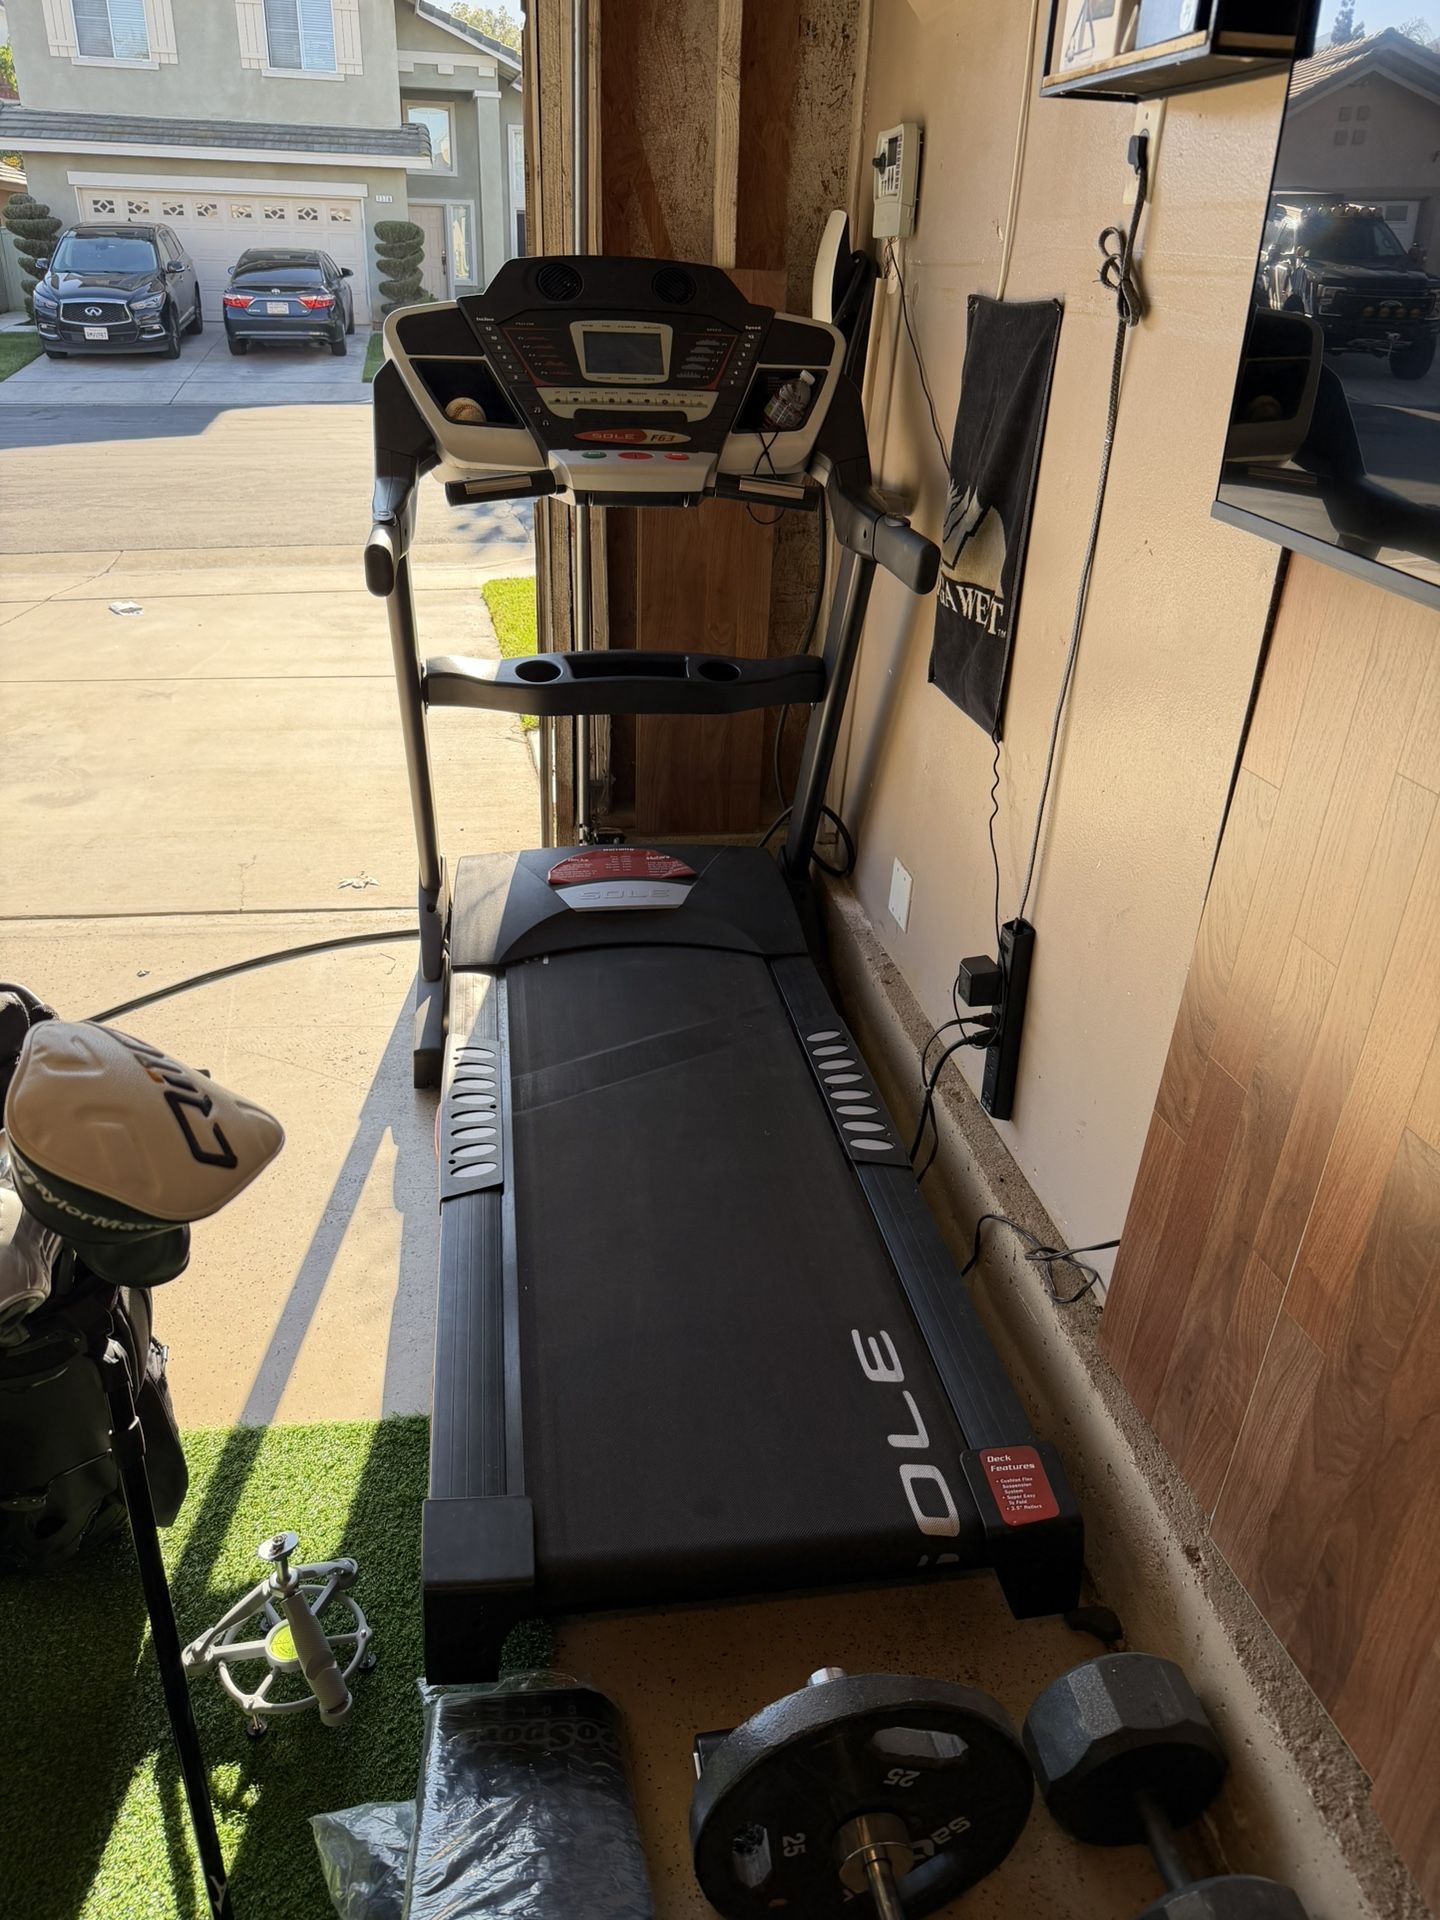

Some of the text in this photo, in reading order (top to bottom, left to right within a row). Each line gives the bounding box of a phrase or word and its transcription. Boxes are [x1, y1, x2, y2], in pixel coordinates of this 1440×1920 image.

[650, 434, 675, 442] F63
[579, 888, 670, 901] SOLE
[851, 1329, 961, 1567] OLE
[986, 1455, 1012, 1463] Deck
[990, 1463, 1036, 1472] Features
[883, 1768, 920, 1787] 25
[783, 1833, 806, 1857] 25
